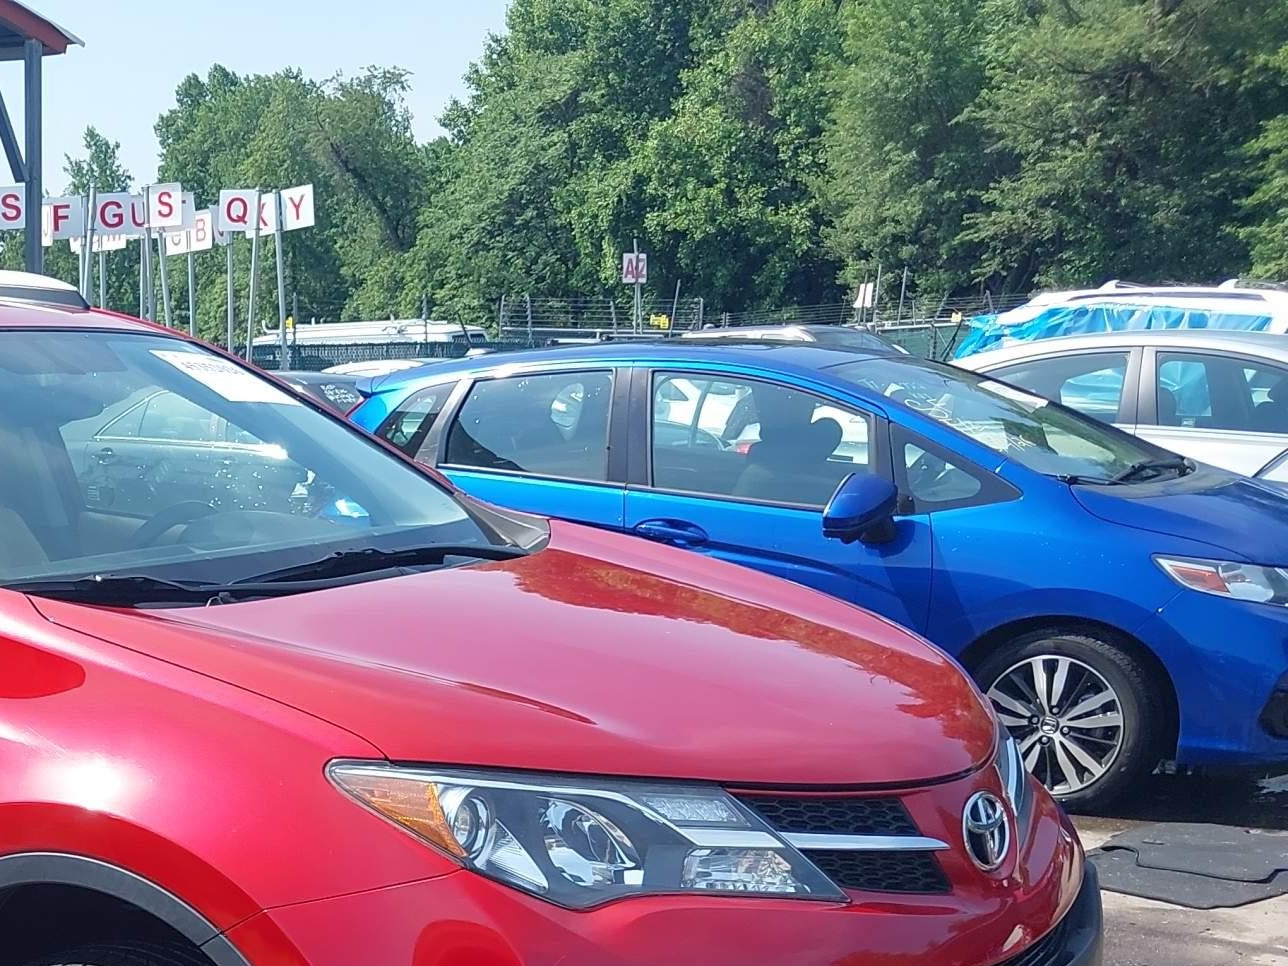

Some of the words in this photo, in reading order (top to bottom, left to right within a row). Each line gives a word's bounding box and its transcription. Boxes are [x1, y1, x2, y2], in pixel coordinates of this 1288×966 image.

[1, 193, 22, 222] S
[53, 204, 70, 232] F
[99, 200, 124, 228] G
[158, 191, 173, 218] S
[226, 197, 248, 225] Q
[289, 194, 305, 221] Y
[196, 218, 206, 242] B
